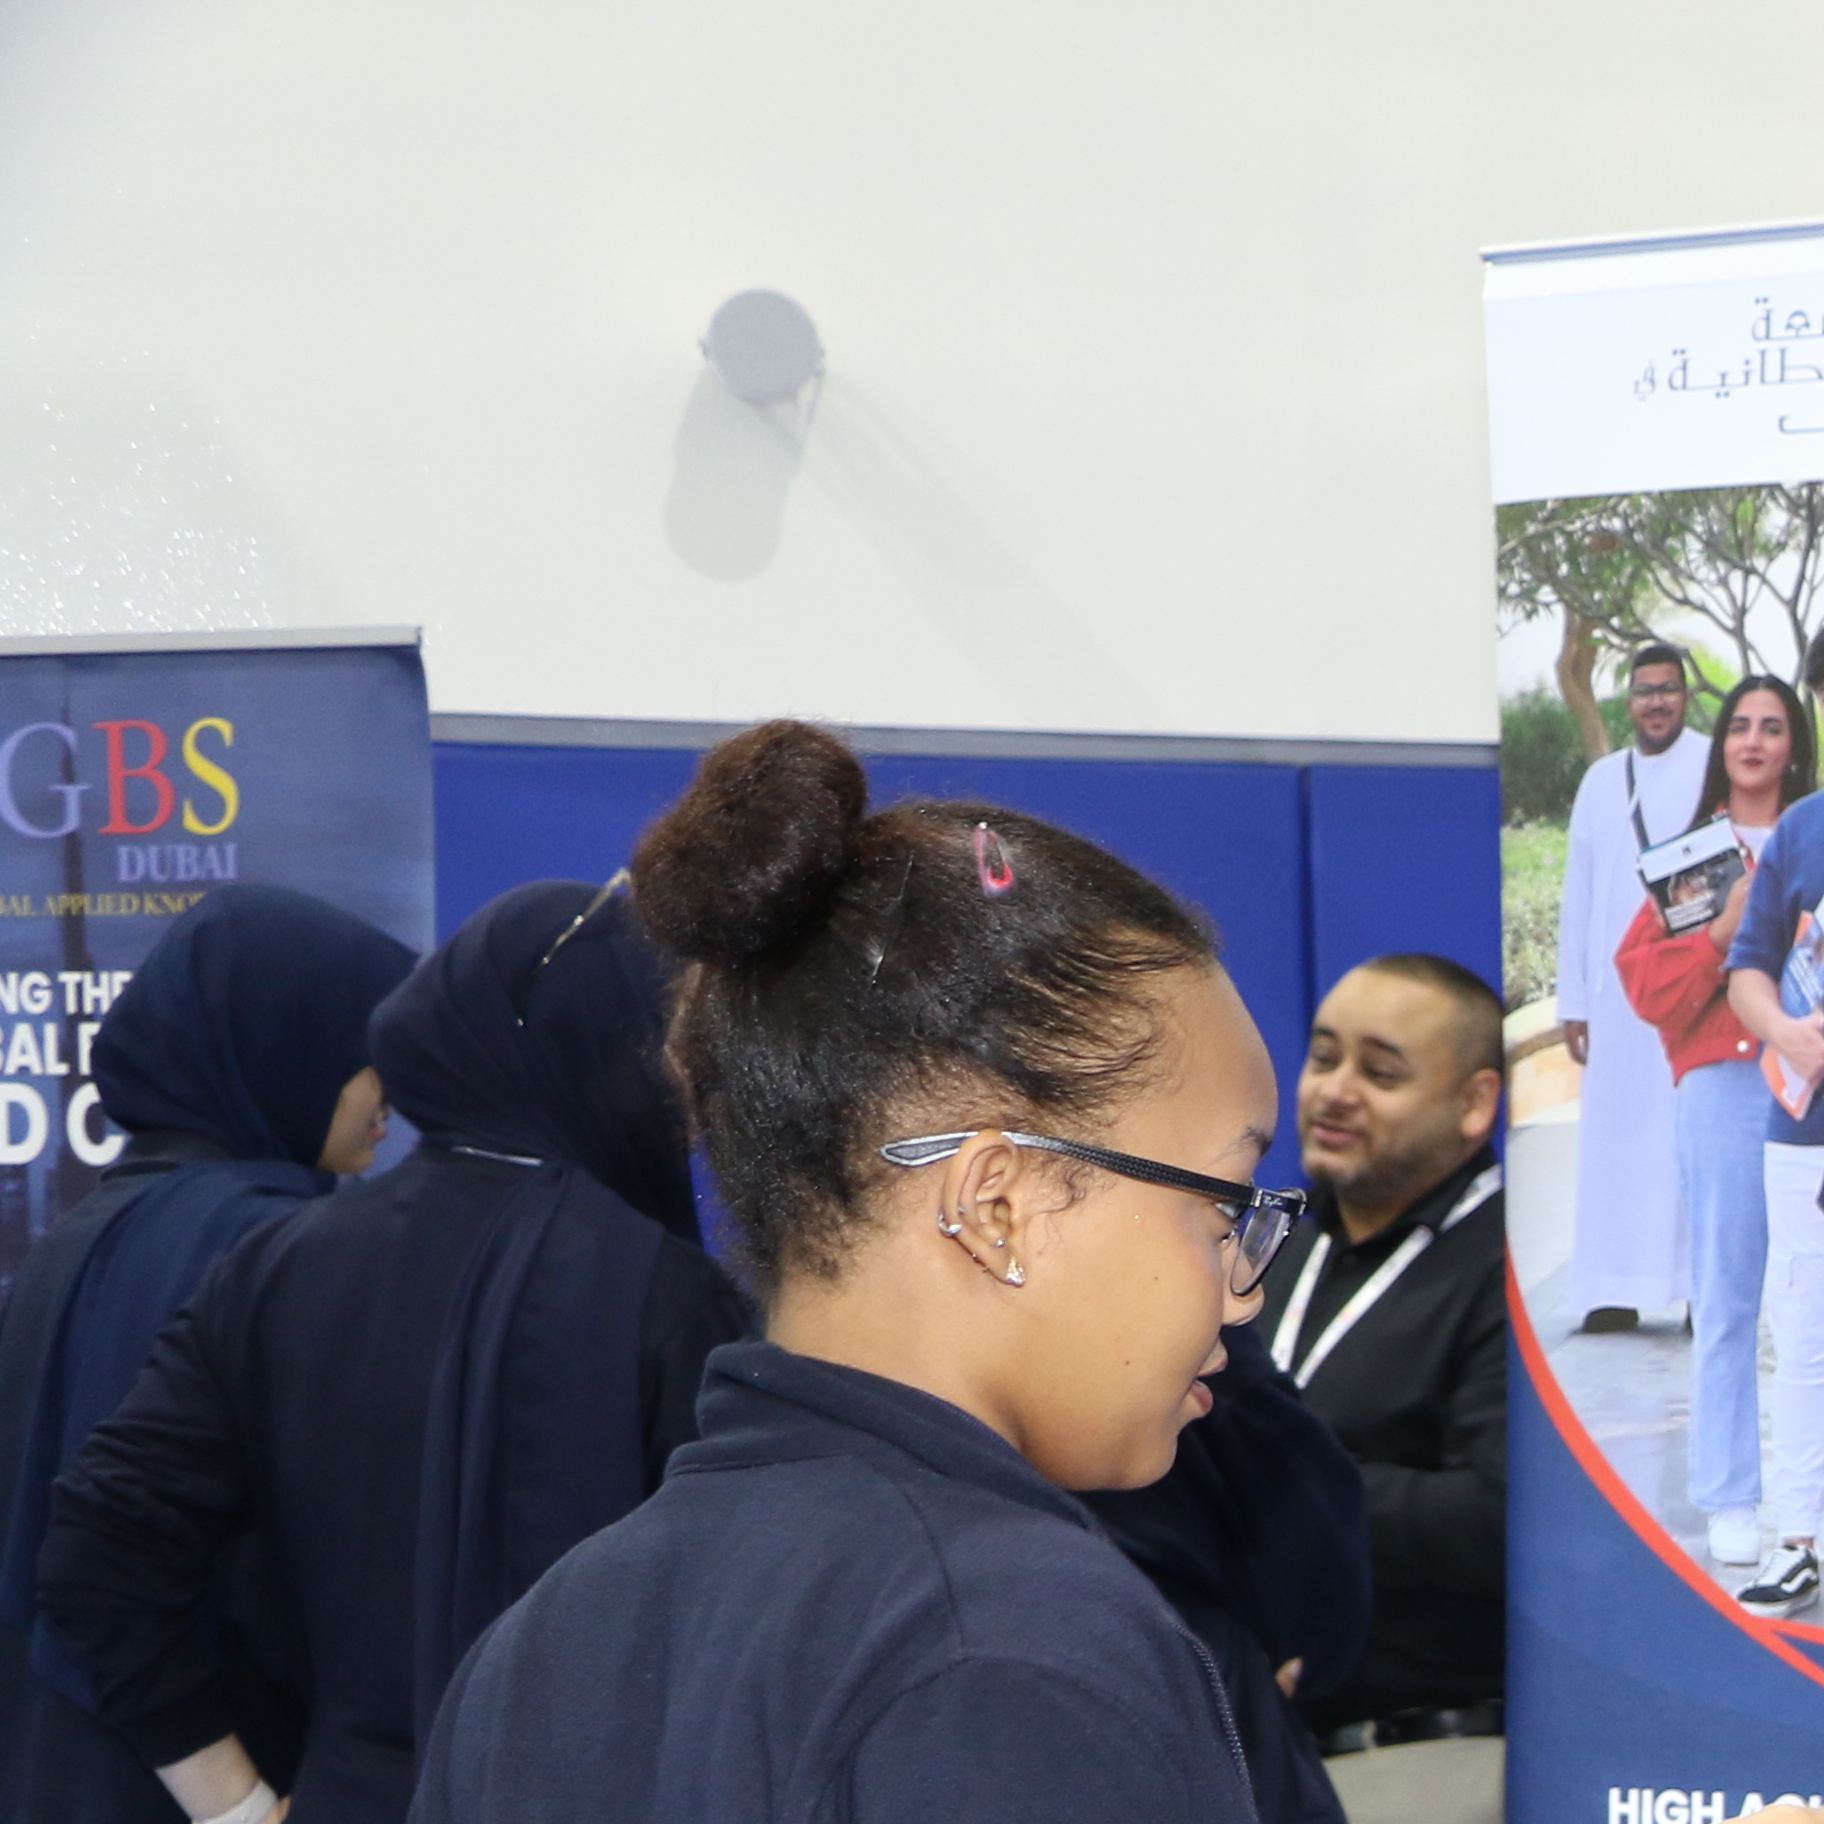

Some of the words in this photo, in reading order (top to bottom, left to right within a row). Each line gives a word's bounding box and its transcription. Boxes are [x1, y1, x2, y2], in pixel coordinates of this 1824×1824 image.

[0, 717, 240, 840] GBS
[117, 843, 239, 881] DUBAI
[46, 892, 140, 916] APPLIED
[0, 1022, 70, 1075] AL
